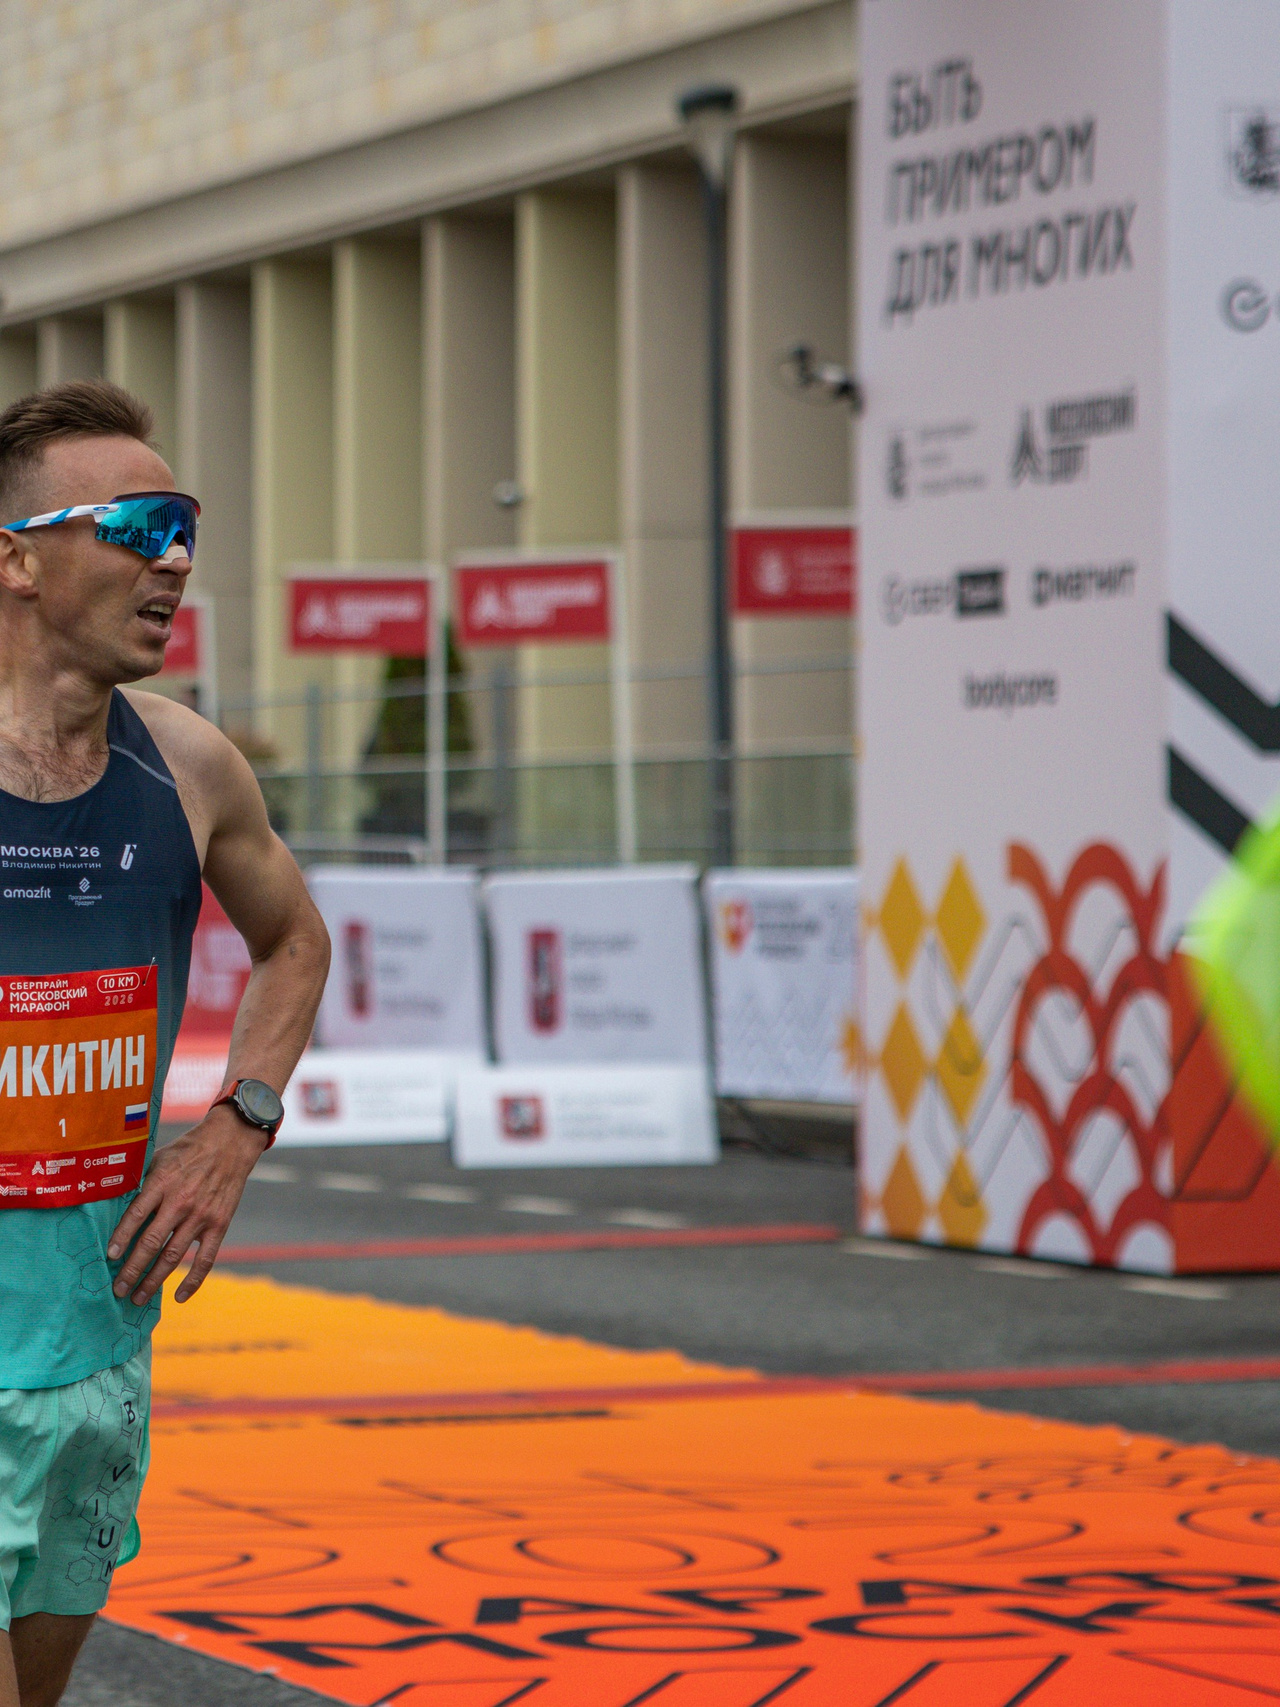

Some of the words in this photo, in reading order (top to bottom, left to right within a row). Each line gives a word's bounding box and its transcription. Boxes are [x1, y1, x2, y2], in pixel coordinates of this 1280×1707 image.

[888, 57, 982, 139] БЫТЬ
[886, 115, 1096, 225] ПРИМЕРОМ
[884, 240, 960, 328] ДЛЯ
[969, 203, 1136, 297] МНОГИХ
[2, 860, 56, 870] Владимир
[3, 886, 51, 898] amazfit
[9, 979, 69, 990] СБЕРПРАЙМ
[103, 978, 115, 989] 10
[118, 976, 134, 988] КМ
[9, 986, 88, 1002] МОСКОВСКИЙ
[104, 993, 134, 1006] 2026
[9, 1001, 70, 1013] МАРАФОН
[58, 1118, 66, 1137] 1
[92, 1157, 108, 1166] СБЕР
